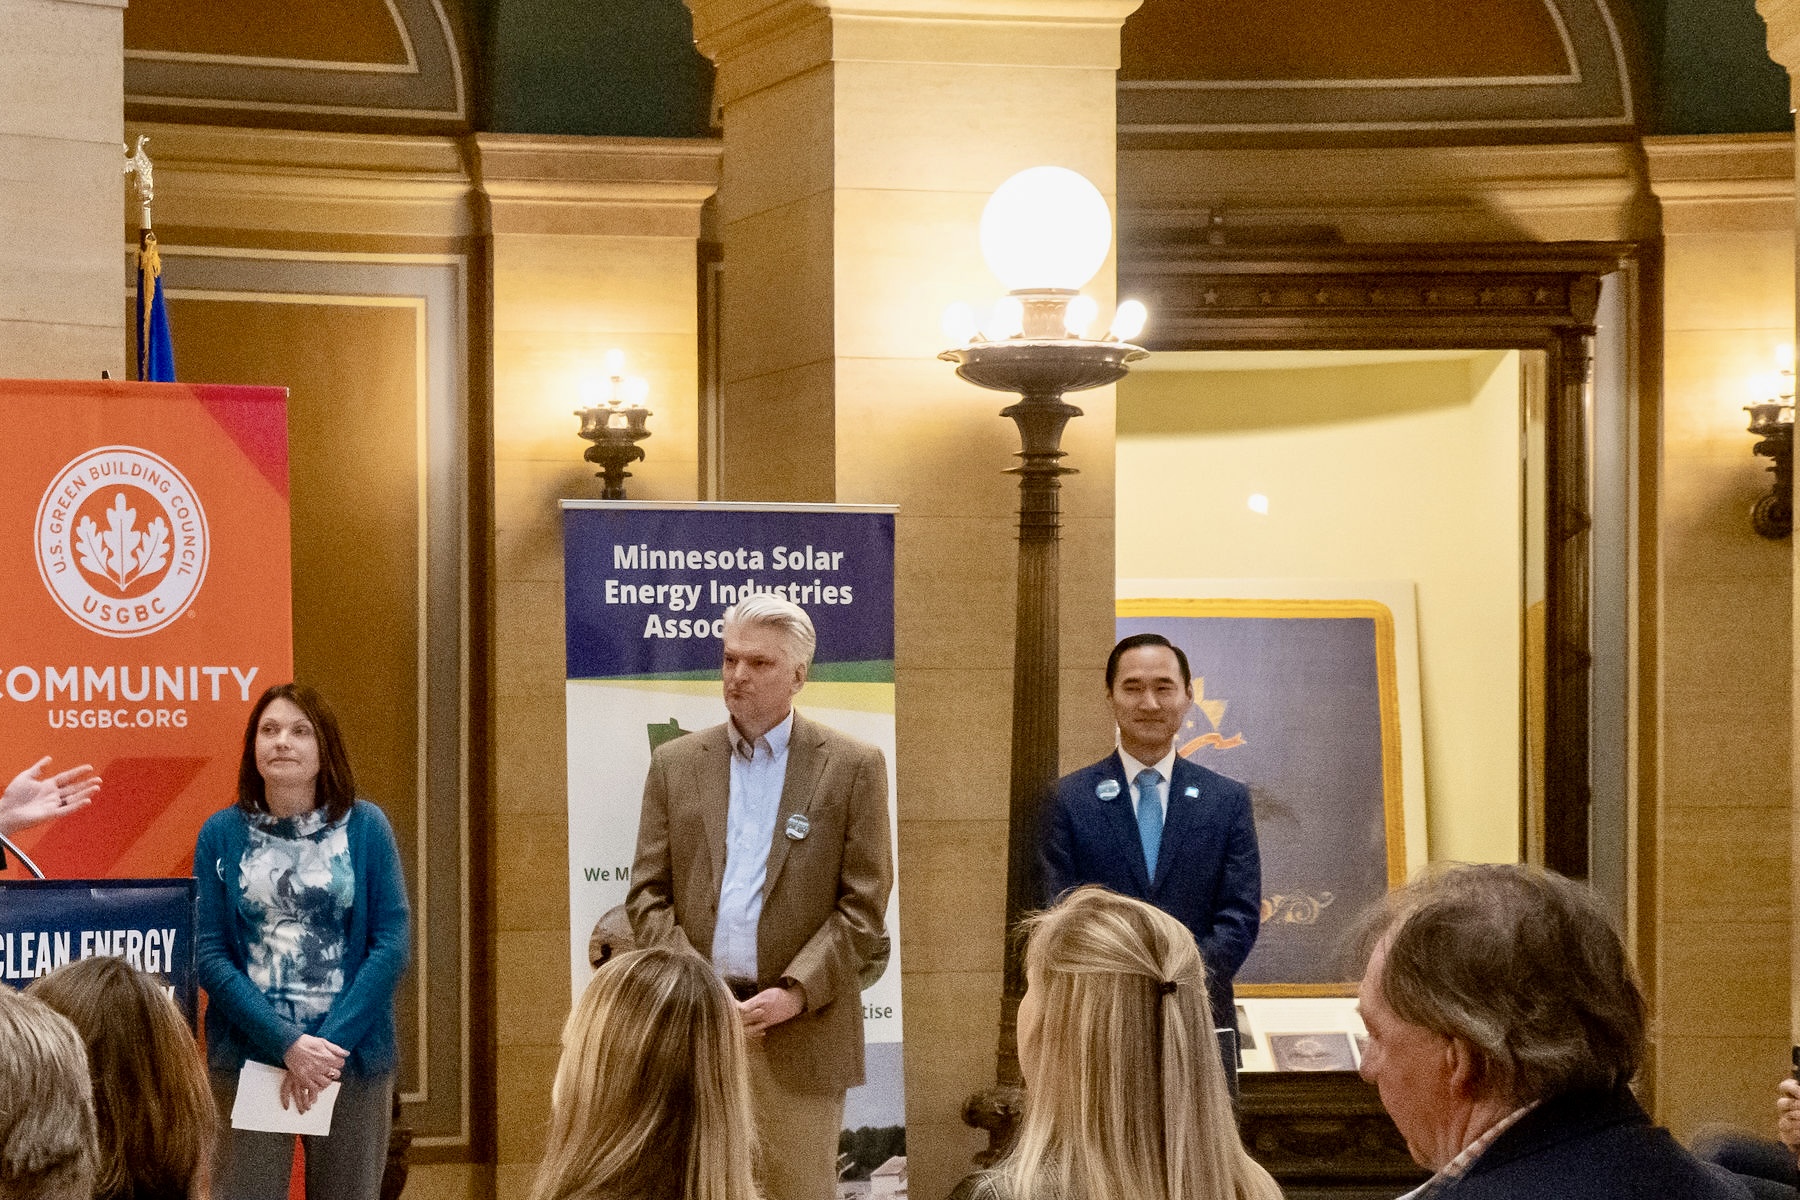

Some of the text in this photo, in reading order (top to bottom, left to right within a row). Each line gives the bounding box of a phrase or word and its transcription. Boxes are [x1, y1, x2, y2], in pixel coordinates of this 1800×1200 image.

[50, 461, 197, 576] U.S. GREEN BUILDING COUNCIL
[613, 543, 844, 571] Minnesota Solar
[82, 595, 166, 625] USGBC
[605, 579, 702, 612] Energy
[48, 708, 188, 729] USGBC.ORG
[584, 867, 610, 882] We
[80, 928, 177, 974] ENERGY
